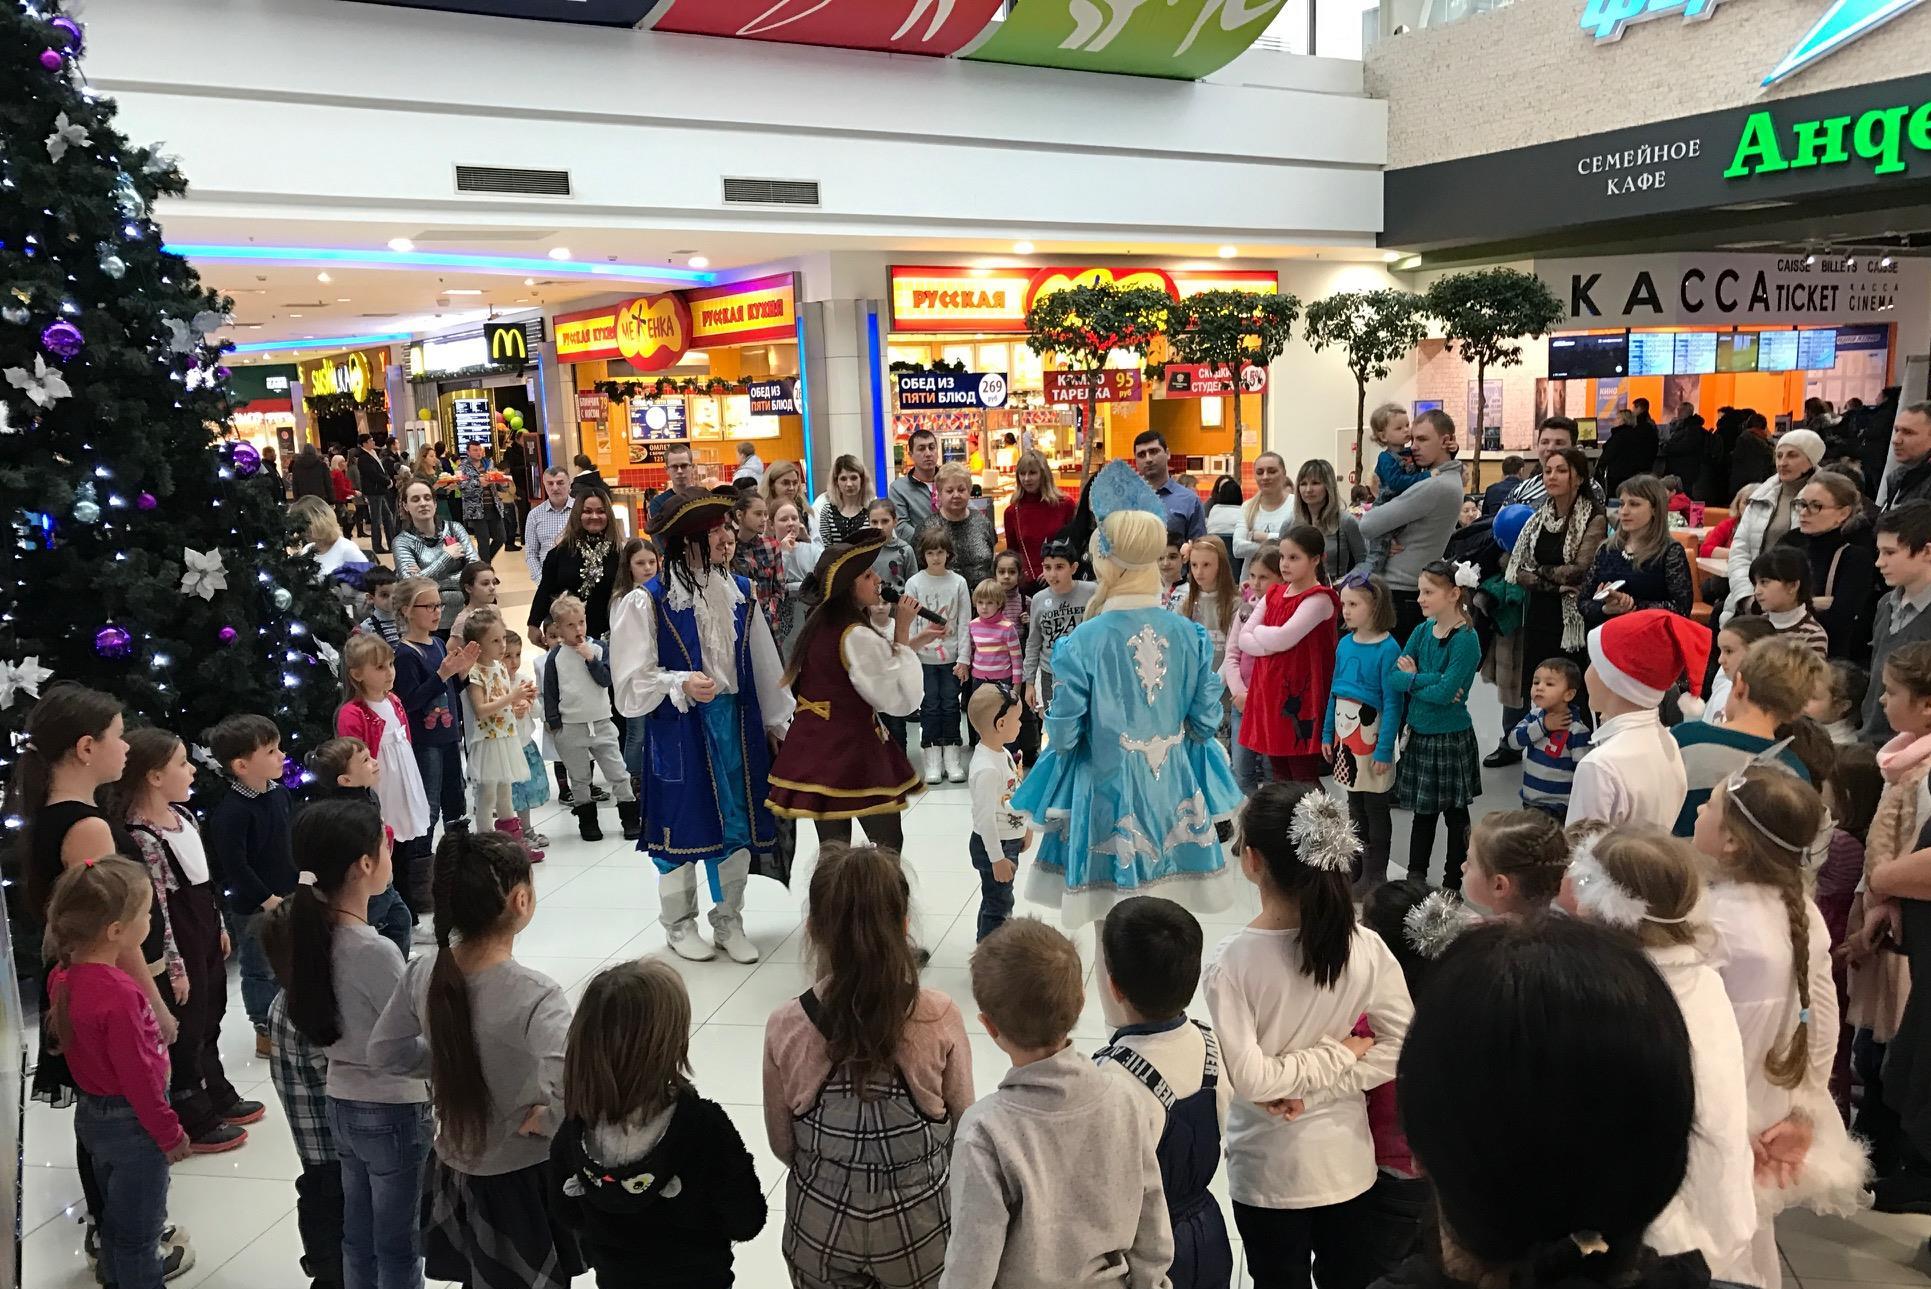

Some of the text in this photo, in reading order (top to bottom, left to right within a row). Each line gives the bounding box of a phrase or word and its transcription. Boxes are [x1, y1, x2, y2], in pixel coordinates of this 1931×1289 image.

[1578, 139, 1700, 175] СЕМЕЙНОЕ
[1607, 171, 1665, 195] КАФЕ
[913, 290, 1005, 308] РУССКАЯ
[1571, 268, 1770, 317] КАССА
[1776, 283, 1839, 312] TICKET
[1849, 295, 1894, 311] CINEMA
[702, 299, 784, 327] РУССКАЯ КУХНЯ
[901, 377, 955, 391] ОБЕД ИЗ
[982, 380, 1003, 393] 269
[1115, 372, 1134, 387] 95
[751, 385, 781, 398] ОБЕД ИЗ
[902, 391, 976, 404] ПЯТИ БЛЮД
[1119, 388, 1132, 398] руб
[751, 399, 793, 411] ПЯТИ БЛЮД
